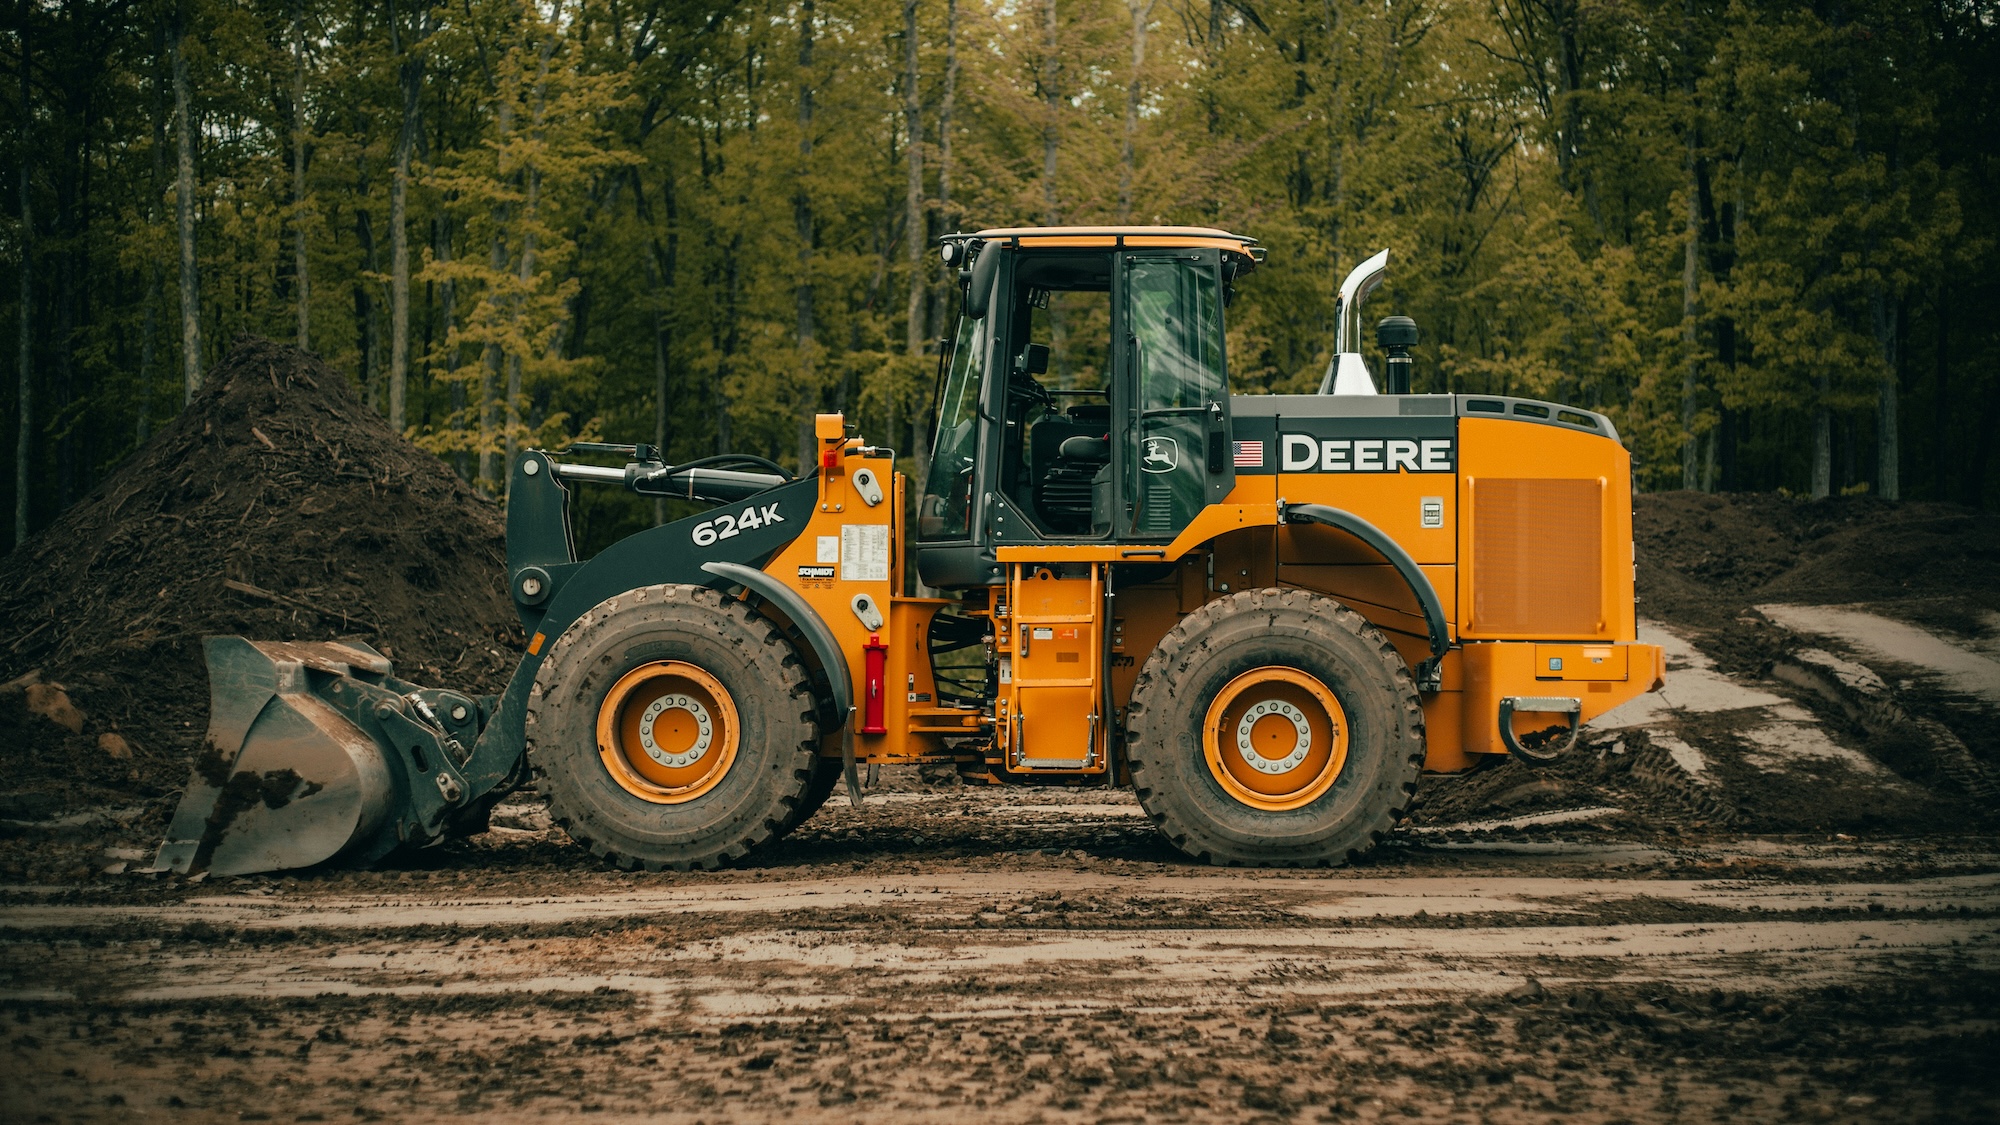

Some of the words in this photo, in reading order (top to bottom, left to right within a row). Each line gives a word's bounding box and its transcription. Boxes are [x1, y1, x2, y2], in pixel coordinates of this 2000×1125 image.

[1282, 434, 1451, 471] DEERE
[692, 502, 785, 546] 624K
[798, 567, 834, 577] SCHMIDT
